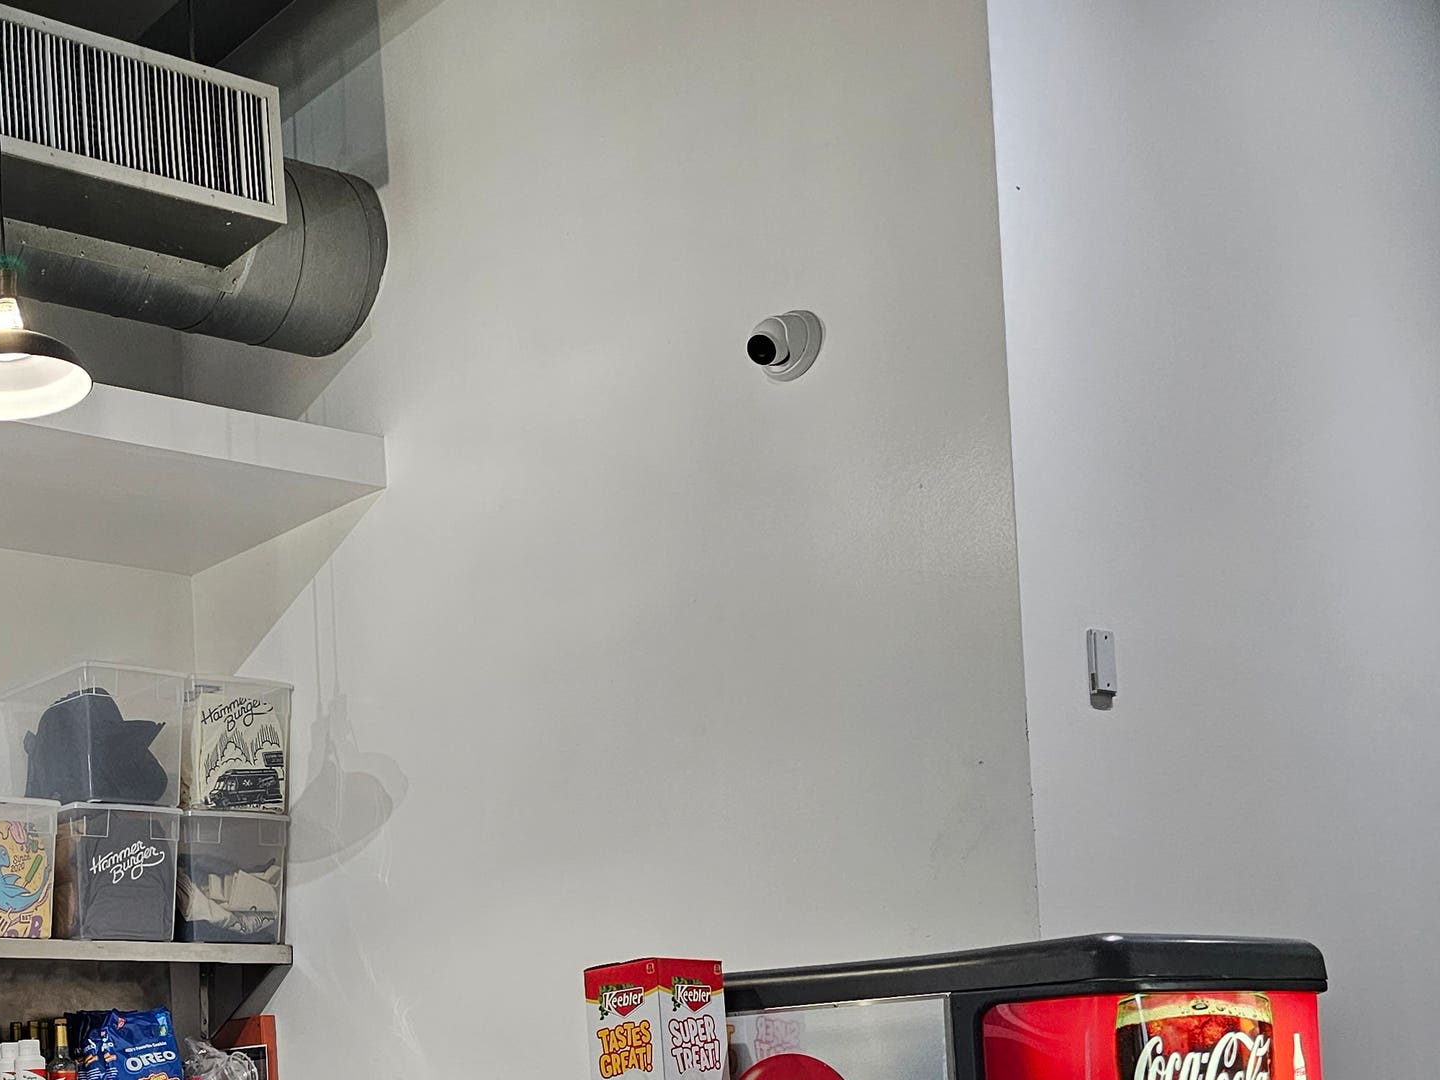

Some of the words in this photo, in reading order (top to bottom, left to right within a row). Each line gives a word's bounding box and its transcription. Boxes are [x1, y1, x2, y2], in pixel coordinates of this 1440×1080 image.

[90, 840, 146, 874] Hammer
[109, 845, 165, 884] Burger
[603, 989, 644, 1010] Keebler
[676, 988, 712, 1006] Keebler
[598, 1020, 652, 1055] TASTES
[669, 1015, 716, 1046] SUPER
[126, 1050, 176, 1072] OREO
[599, 1044, 653, 1079] GREAT!
[672, 1040, 721, 1074] TREAT!
